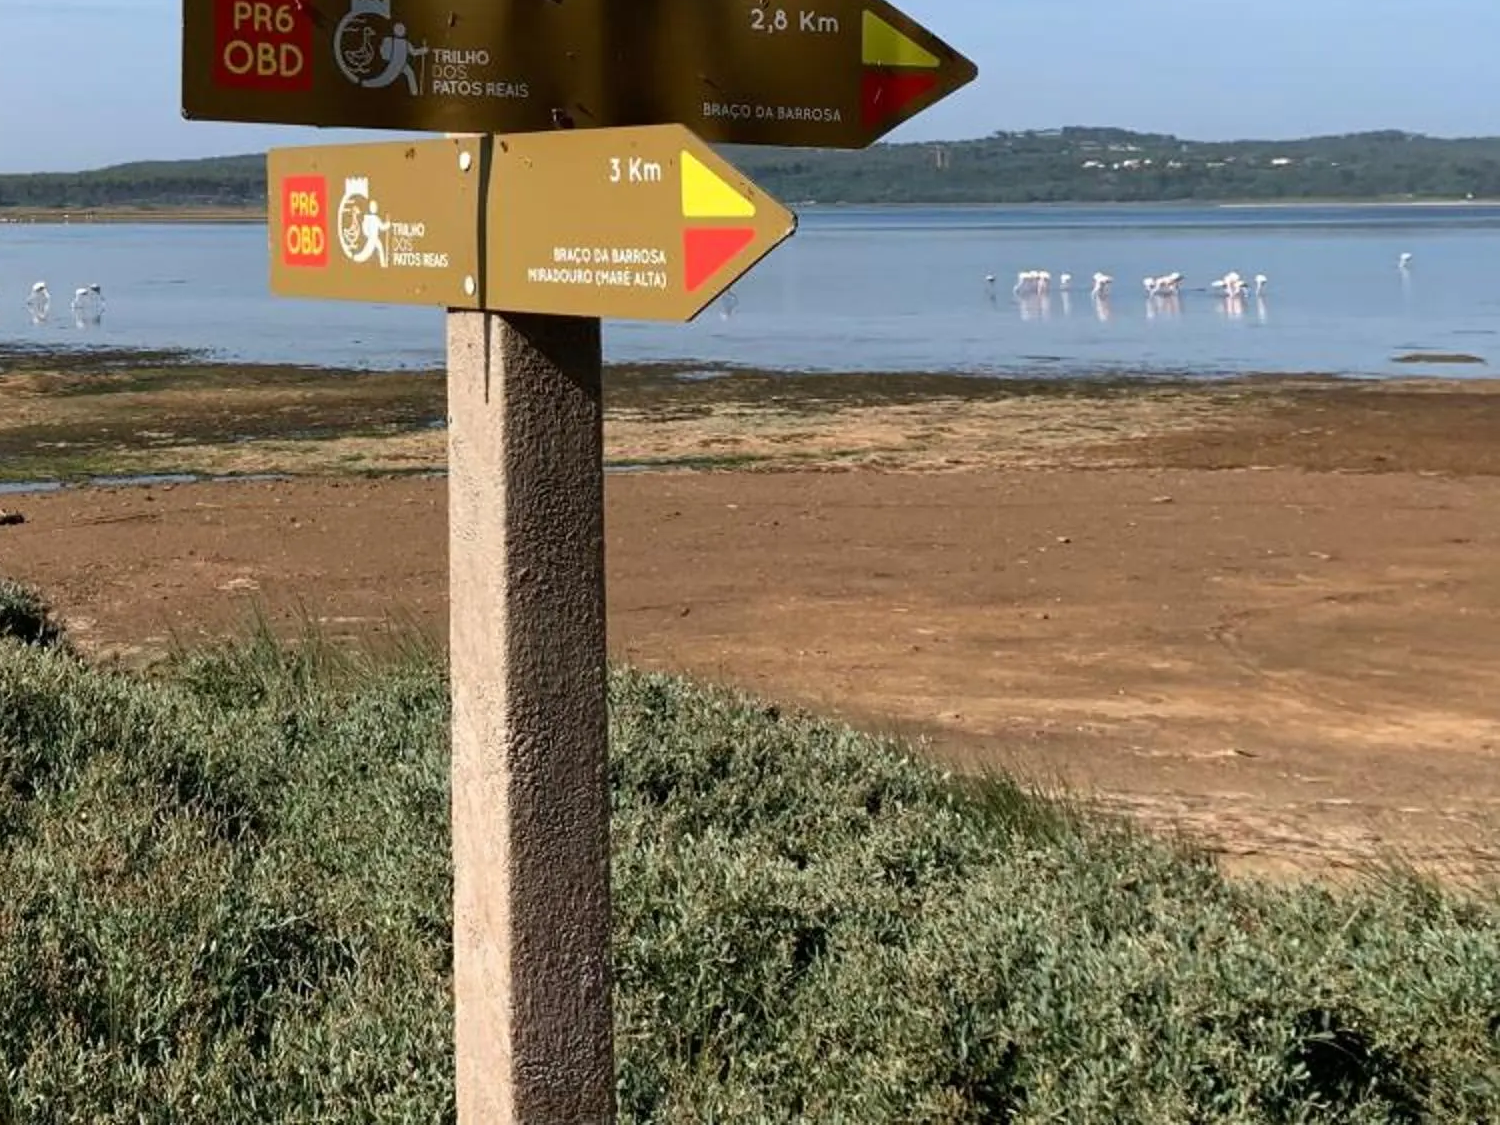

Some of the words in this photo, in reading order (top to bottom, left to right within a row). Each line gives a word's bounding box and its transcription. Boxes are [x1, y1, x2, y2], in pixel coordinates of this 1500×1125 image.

[233, 0, 295, 34] PR6
[750, 8, 788, 34] 2,8
[800, 10, 840, 33] Km
[223, 40, 303, 77] OBD
[432, 48, 490, 66] TRILHO
[432, 65, 467, 79] DOS
[432, 80, 482, 97] PATOS
[486, 82, 529, 98] REAIS
[702, 101, 751, 120] BRAÇO
[756, 103, 775, 119] DA
[777, 103, 841, 122] BARROSA
[609, 158, 620, 182] 3
[629, 157, 661, 182] Km
[290, 190, 320, 217] PR6
[286, 226, 324, 256] OBD
[392, 253, 420, 266] PATOS
[553, 247, 591, 264] BRAÇO
[594, 248, 610, 263] DA
[612, 248, 667, 264] BARROSA
[634, 271, 667, 290] ALTA)
